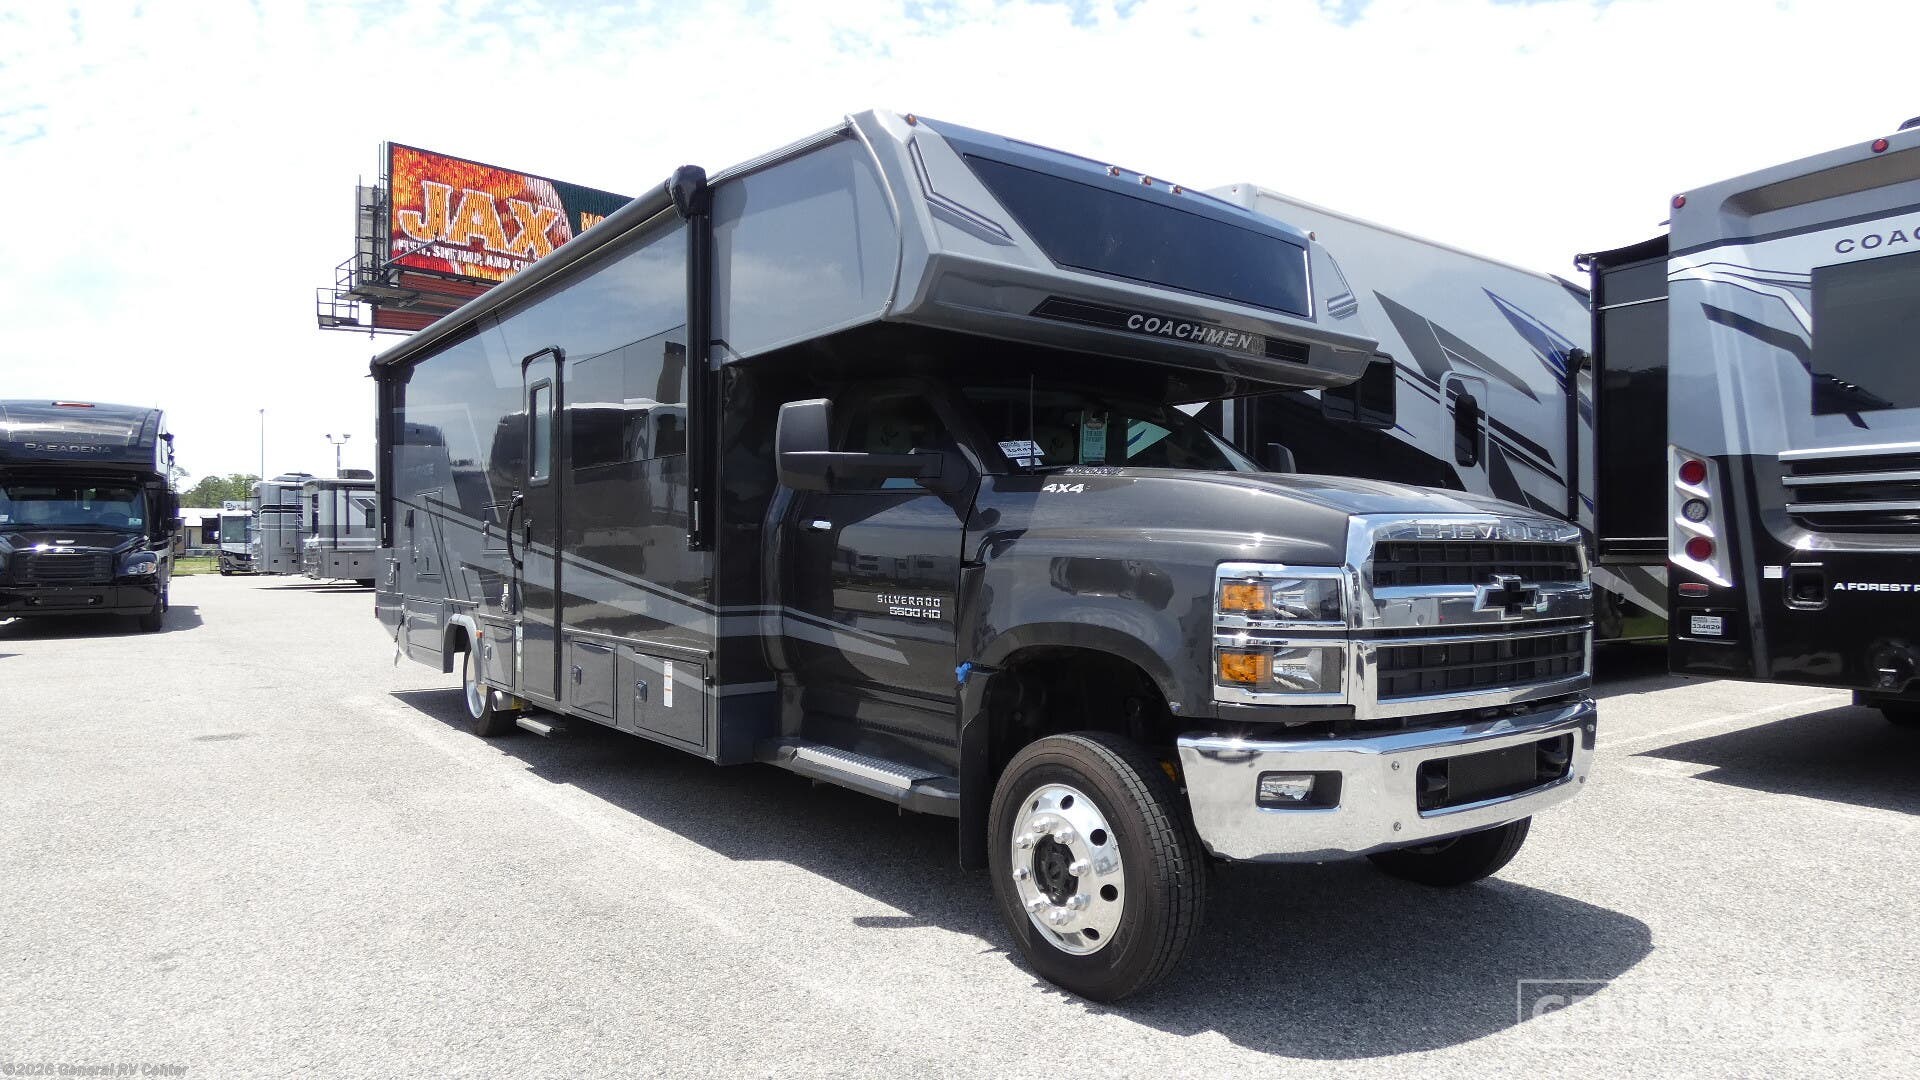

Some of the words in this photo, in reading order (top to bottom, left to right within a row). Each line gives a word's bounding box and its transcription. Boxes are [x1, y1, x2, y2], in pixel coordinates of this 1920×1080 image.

[399, 179, 558, 257] JAX
[486, 252, 512, 269] AND
[1127, 314, 1252, 349] COACHMEN
[24, 443, 112, 453] PASADENA
[1042, 483, 1085, 493] 4X4
[1833, 582, 1846, 591] A
[1847, 582, 1912, 592] FOREST
[877, 594, 941, 608] SILVERADO
[922, 609, 941, 619] HD
